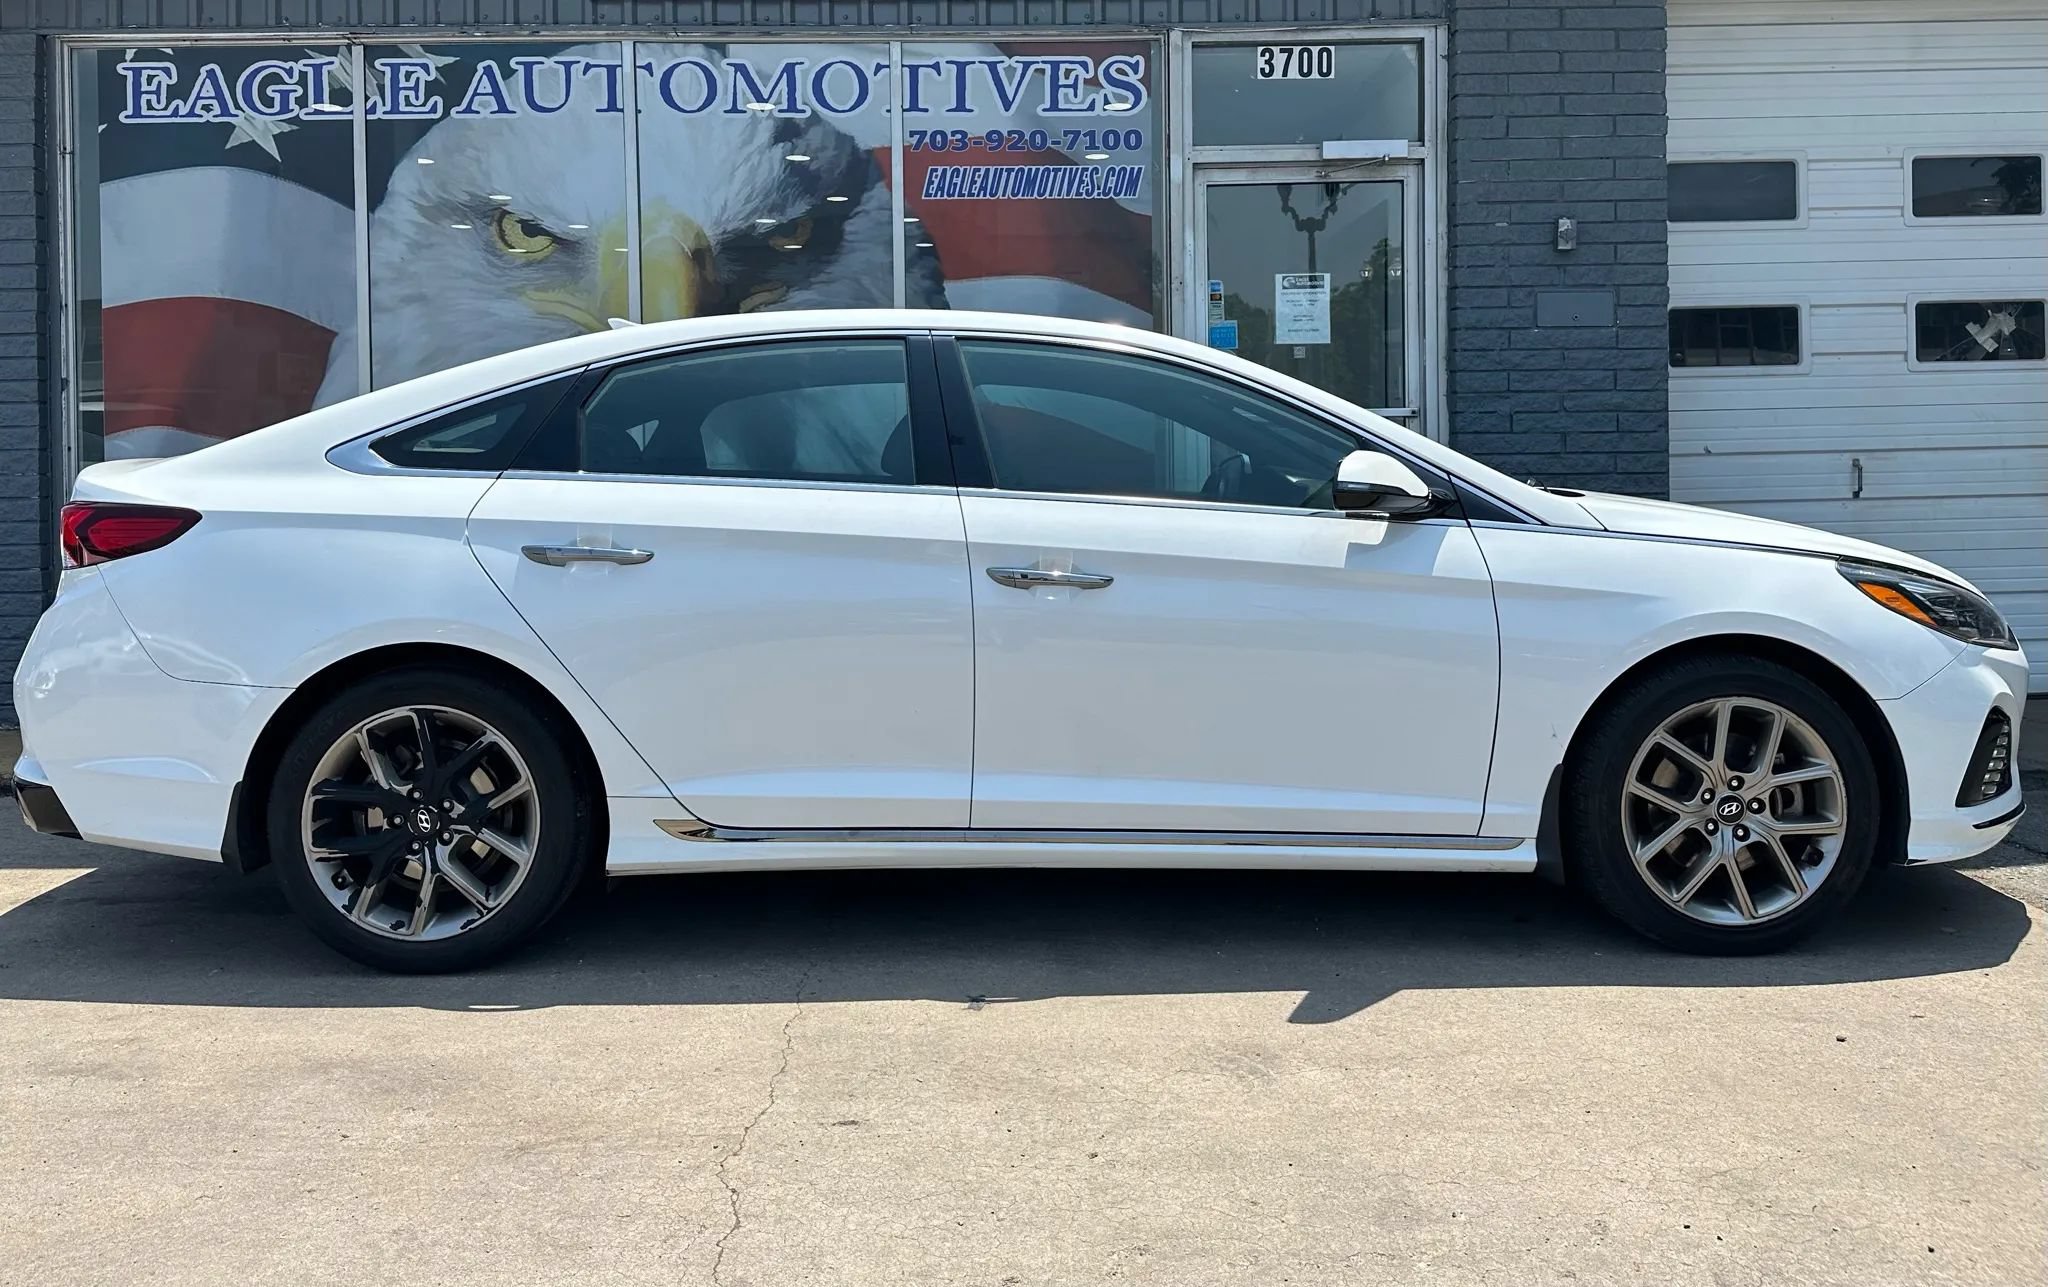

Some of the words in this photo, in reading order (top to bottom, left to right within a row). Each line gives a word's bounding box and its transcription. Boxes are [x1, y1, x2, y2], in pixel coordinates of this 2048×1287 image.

[1259, 46, 1333, 78] 3700
[118, 60, 442, 122] EAGLE
[453, 56, 1147, 116] AUTOMOTIVES
[908, 129, 1143, 152] 703-920-7100
[923, 166, 1144, 199] EAGLEAUTOMOTIVES.COM
